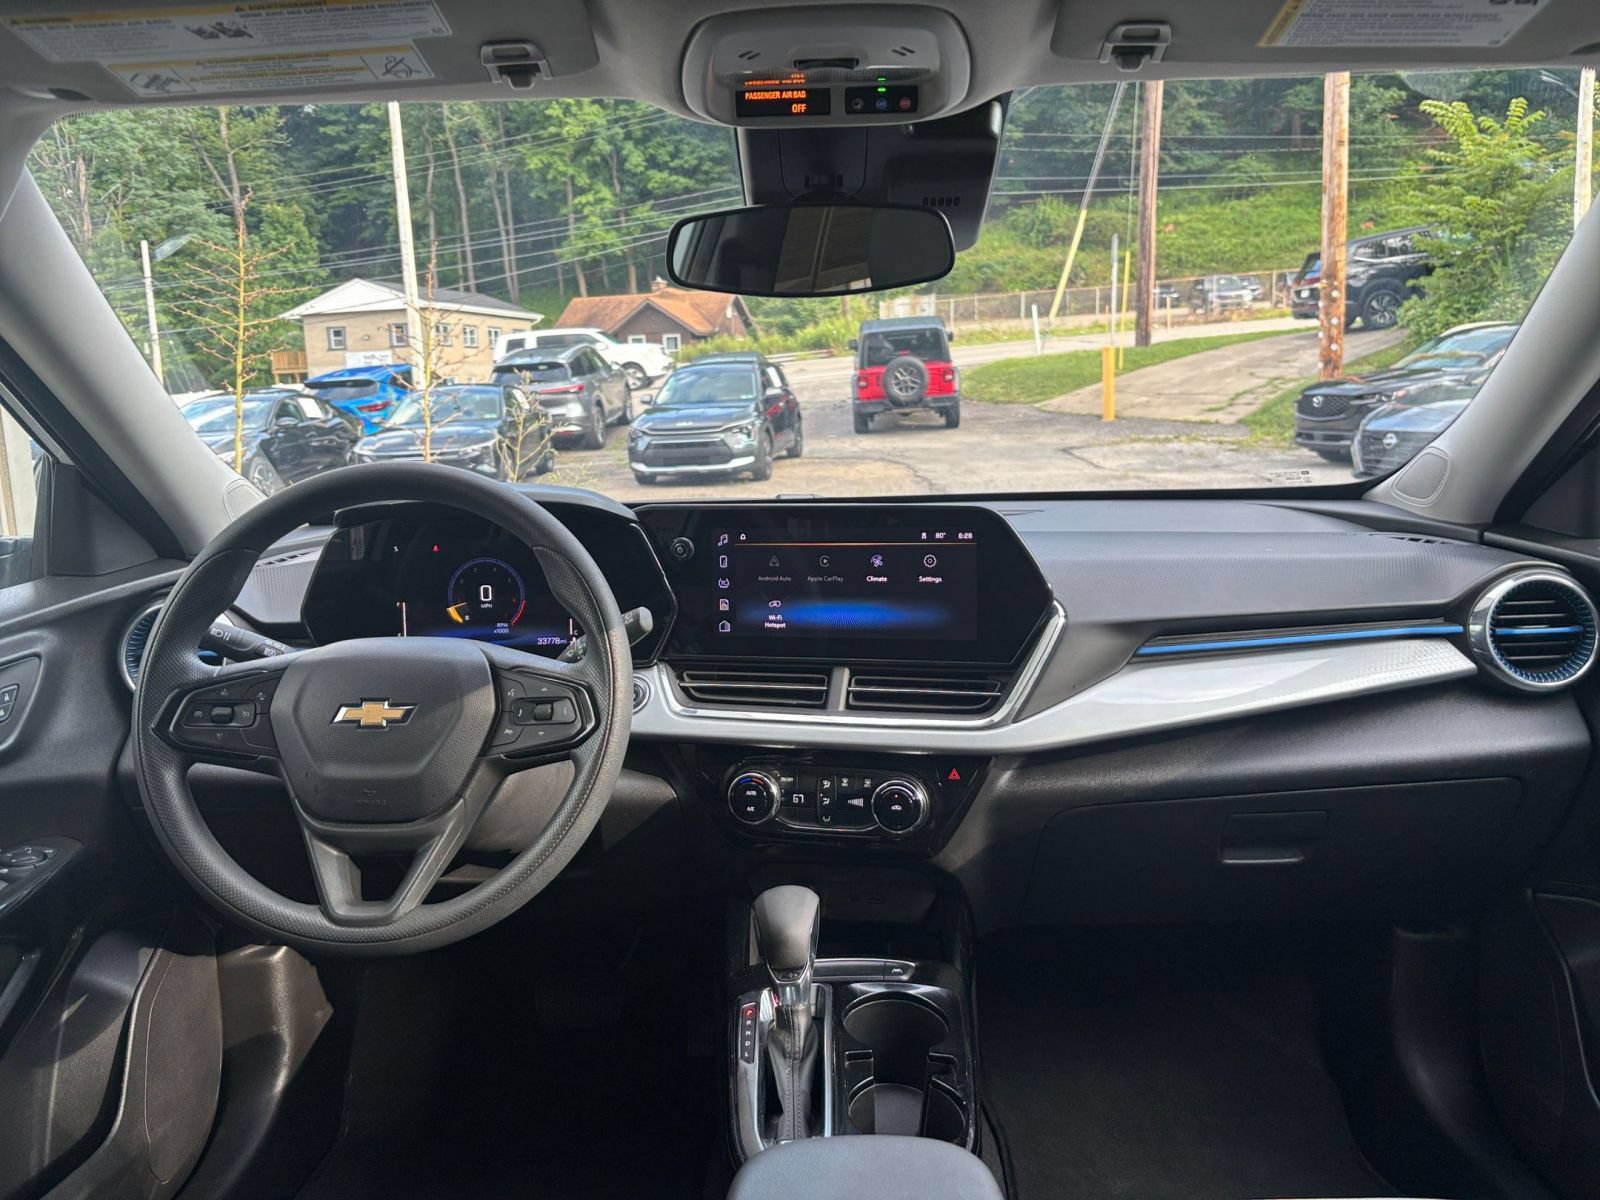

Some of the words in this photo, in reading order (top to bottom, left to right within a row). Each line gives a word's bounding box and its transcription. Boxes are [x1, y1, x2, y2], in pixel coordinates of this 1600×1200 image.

[745, 91, 781, 100] PASSENGER
[792, 103, 807, 113] OFF
[918, 575, 942, 583] Settings
[480, 585, 492, 601] 0
[537, 637, 561, 645] 33778
[792, 793, 804, 804] 67
